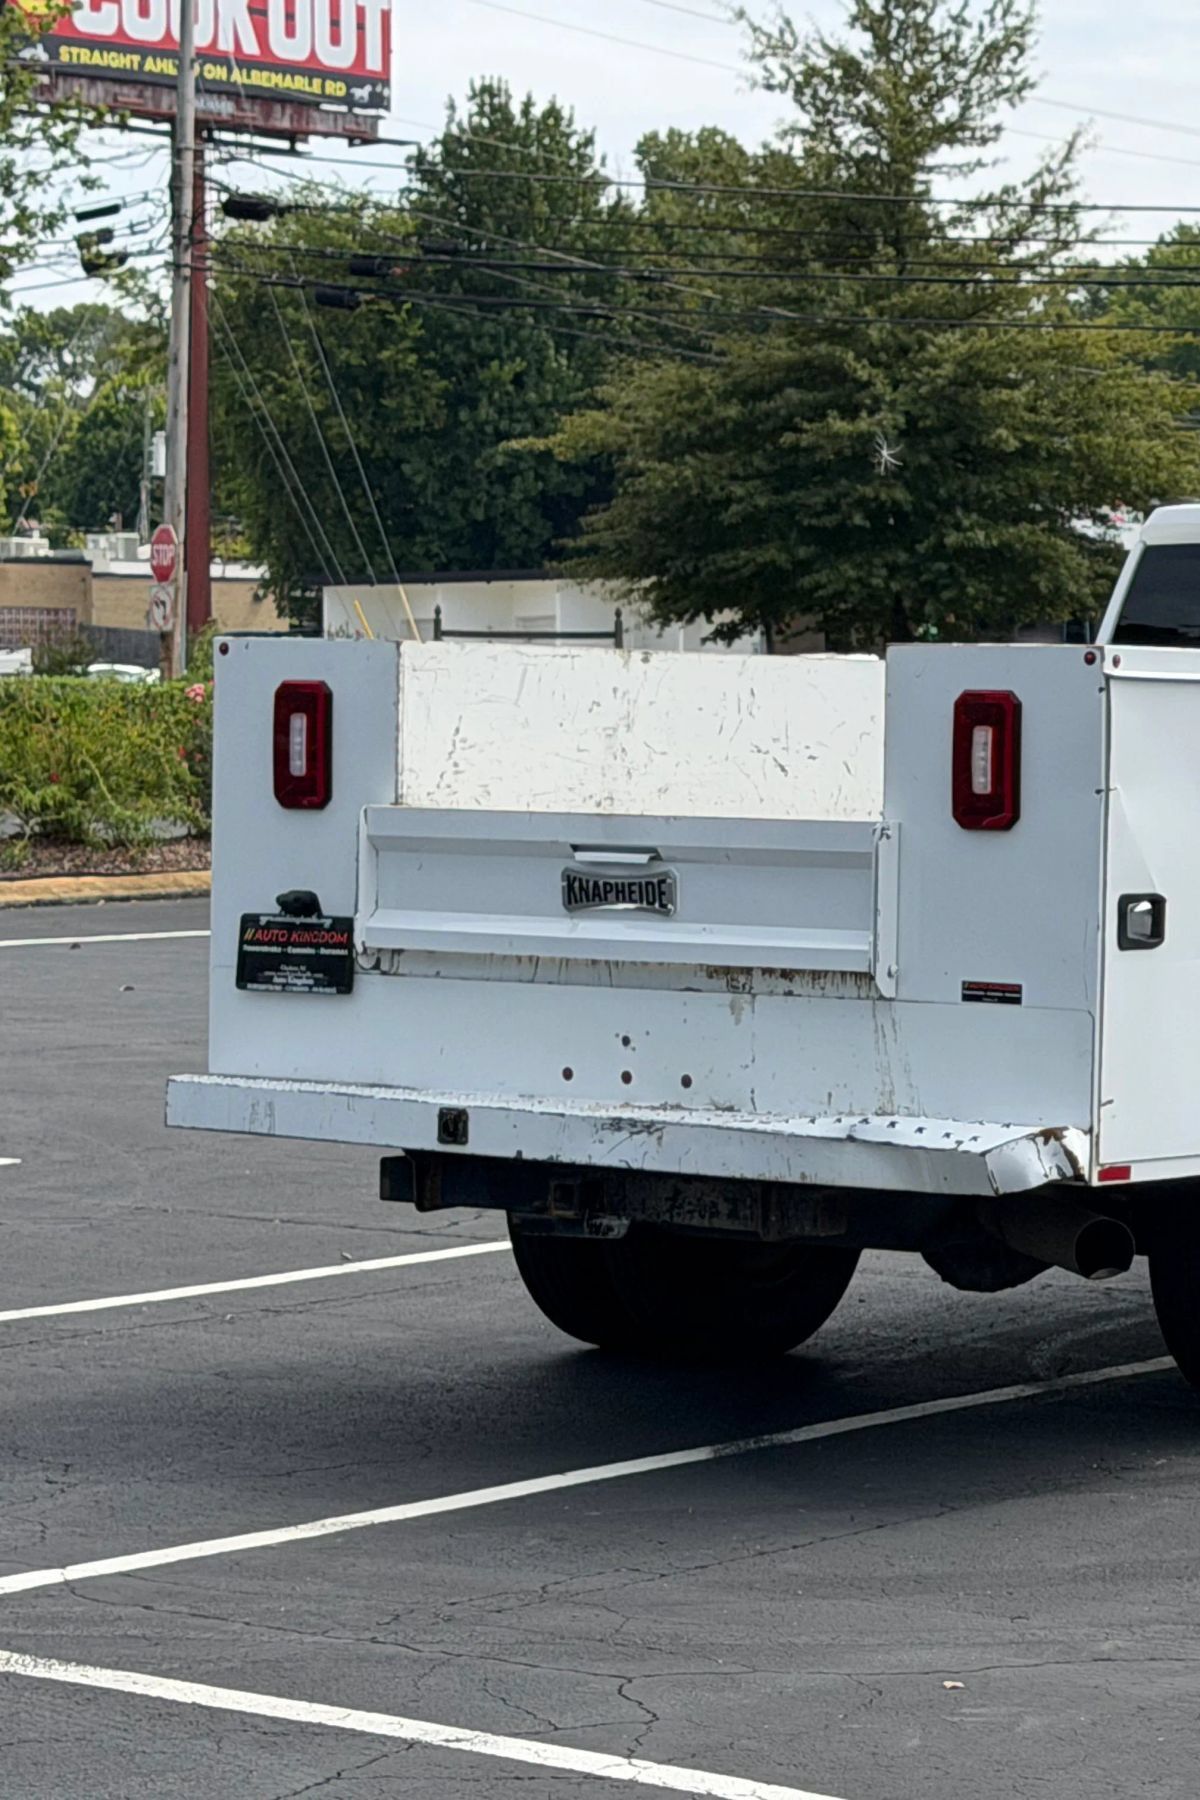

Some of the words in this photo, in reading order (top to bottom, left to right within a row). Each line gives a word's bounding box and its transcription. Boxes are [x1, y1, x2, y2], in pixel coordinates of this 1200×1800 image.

[59, 45, 141, 71] STRAIGHT
[143, 56, 200, 77] AHE
[203, 63, 228, 81] ON
[230, 67, 323, 95] ALBEMARLE
[324, 80, 347, 97] RD
[152, 543, 176, 567] STOP
[565, 874, 669, 910] KNAPHEIDE
[254, 929, 289, 943] AUTO
